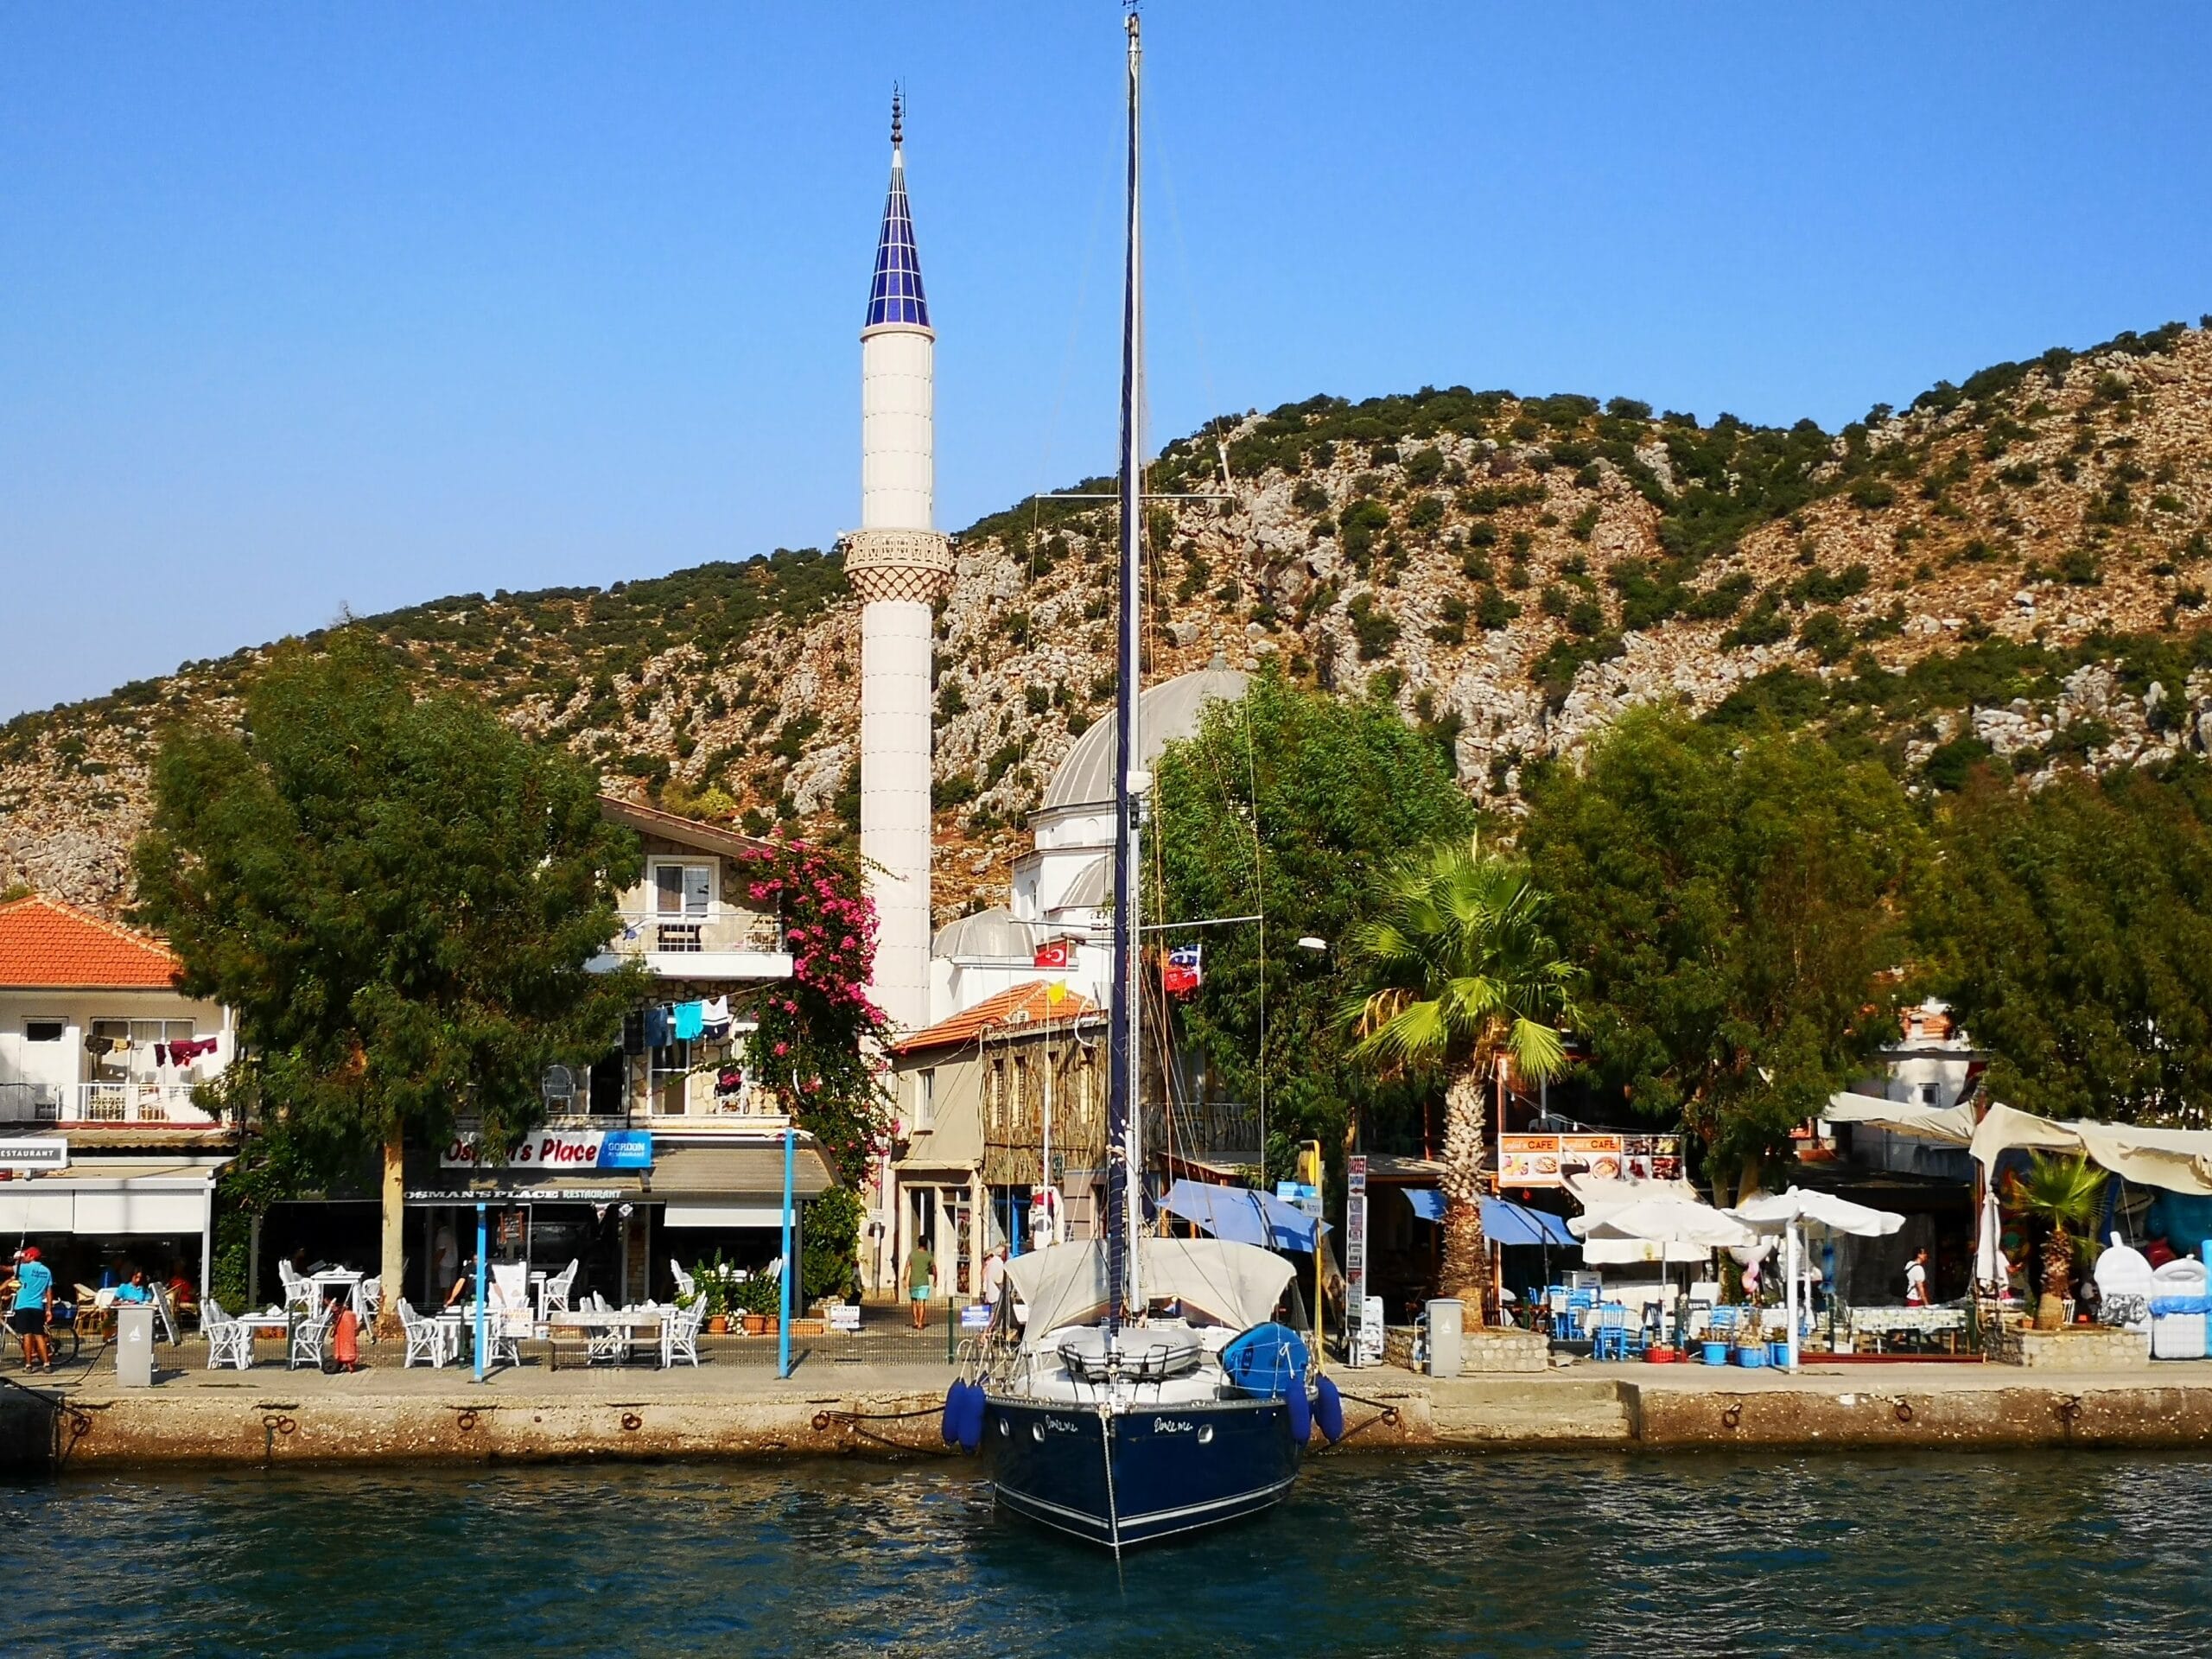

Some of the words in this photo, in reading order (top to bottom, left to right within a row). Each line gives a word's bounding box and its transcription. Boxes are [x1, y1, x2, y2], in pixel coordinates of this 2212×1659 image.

[608, 1142, 645, 1151] GORDON
[1528, 1141, 1554, 1149] CAFE
[1590, 1140, 1616, 1148] CAFE
[539, 1137, 597, 1162] Place
[404, 1191, 491, 1199] OSMAN'S
[493, 1190, 559, 1199] PLACE
[563, 1189, 621, 1199] RESTAURANT
